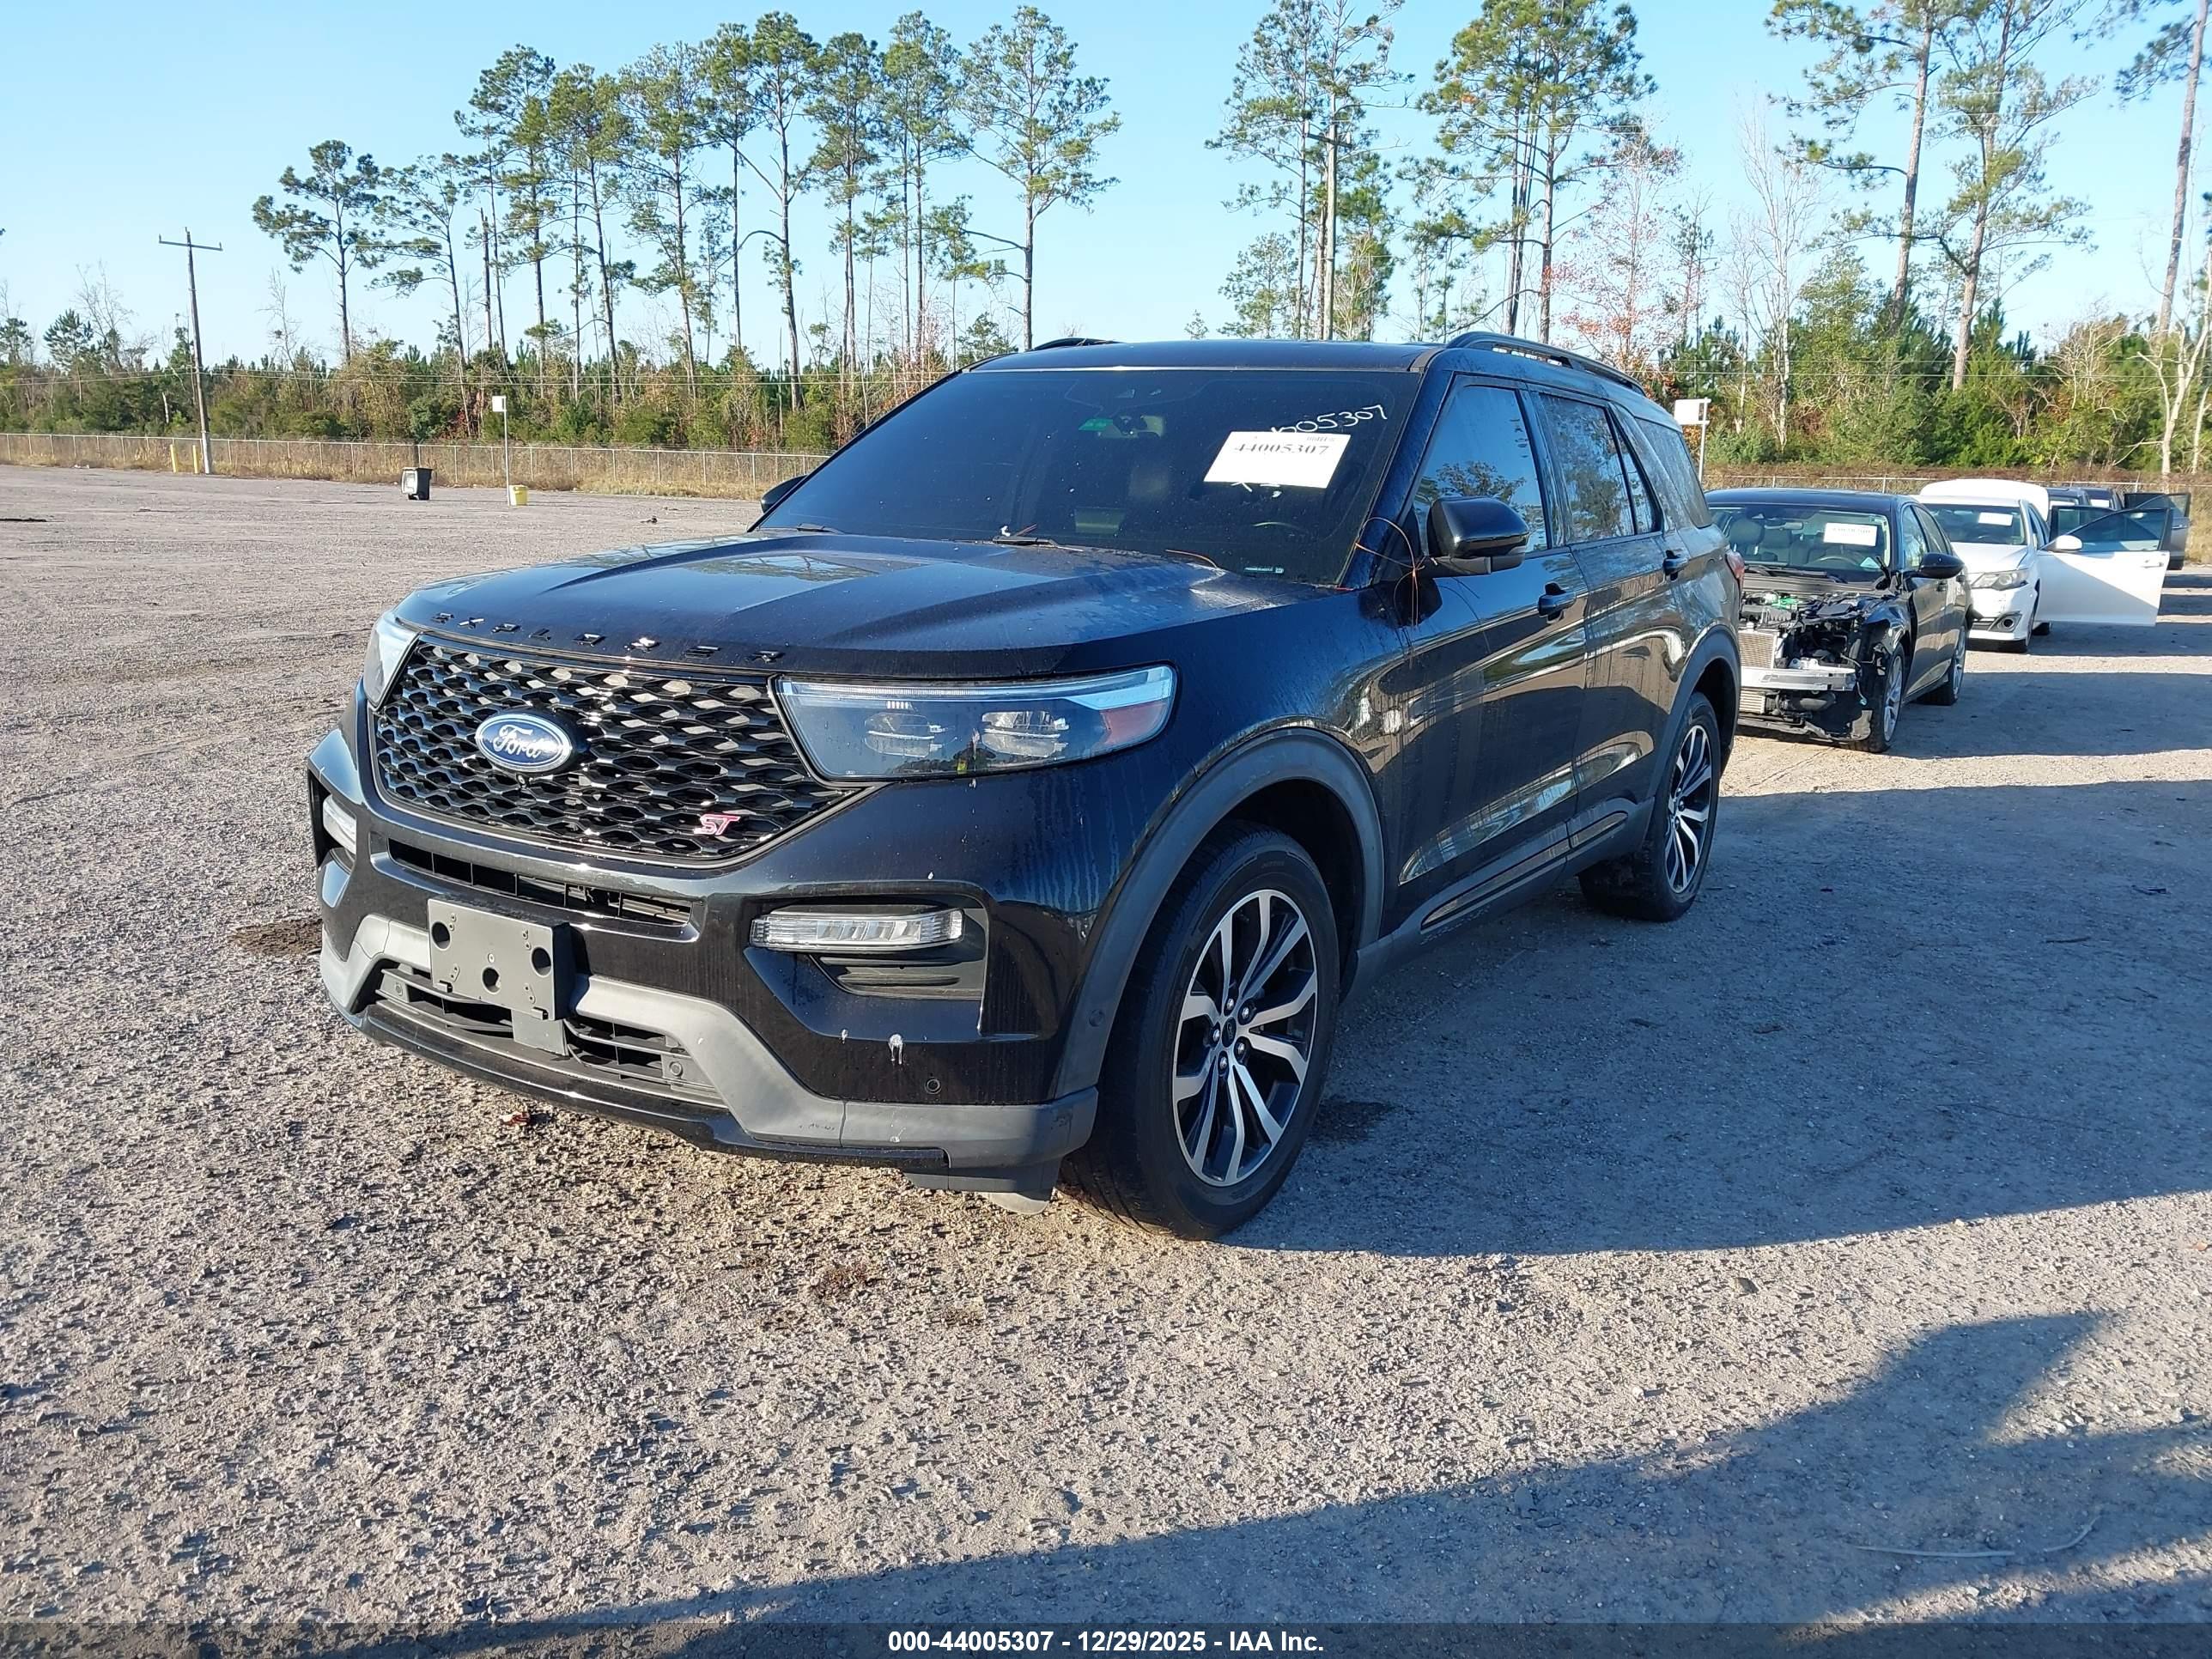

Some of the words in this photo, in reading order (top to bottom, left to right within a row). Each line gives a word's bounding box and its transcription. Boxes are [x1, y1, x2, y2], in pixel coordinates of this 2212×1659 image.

[1235, 443, 1329, 455] 44005307
[430, 612, 782, 664] EXPLORER
[493, 725, 551, 759] Ford
[693, 813, 741, 836] ST
